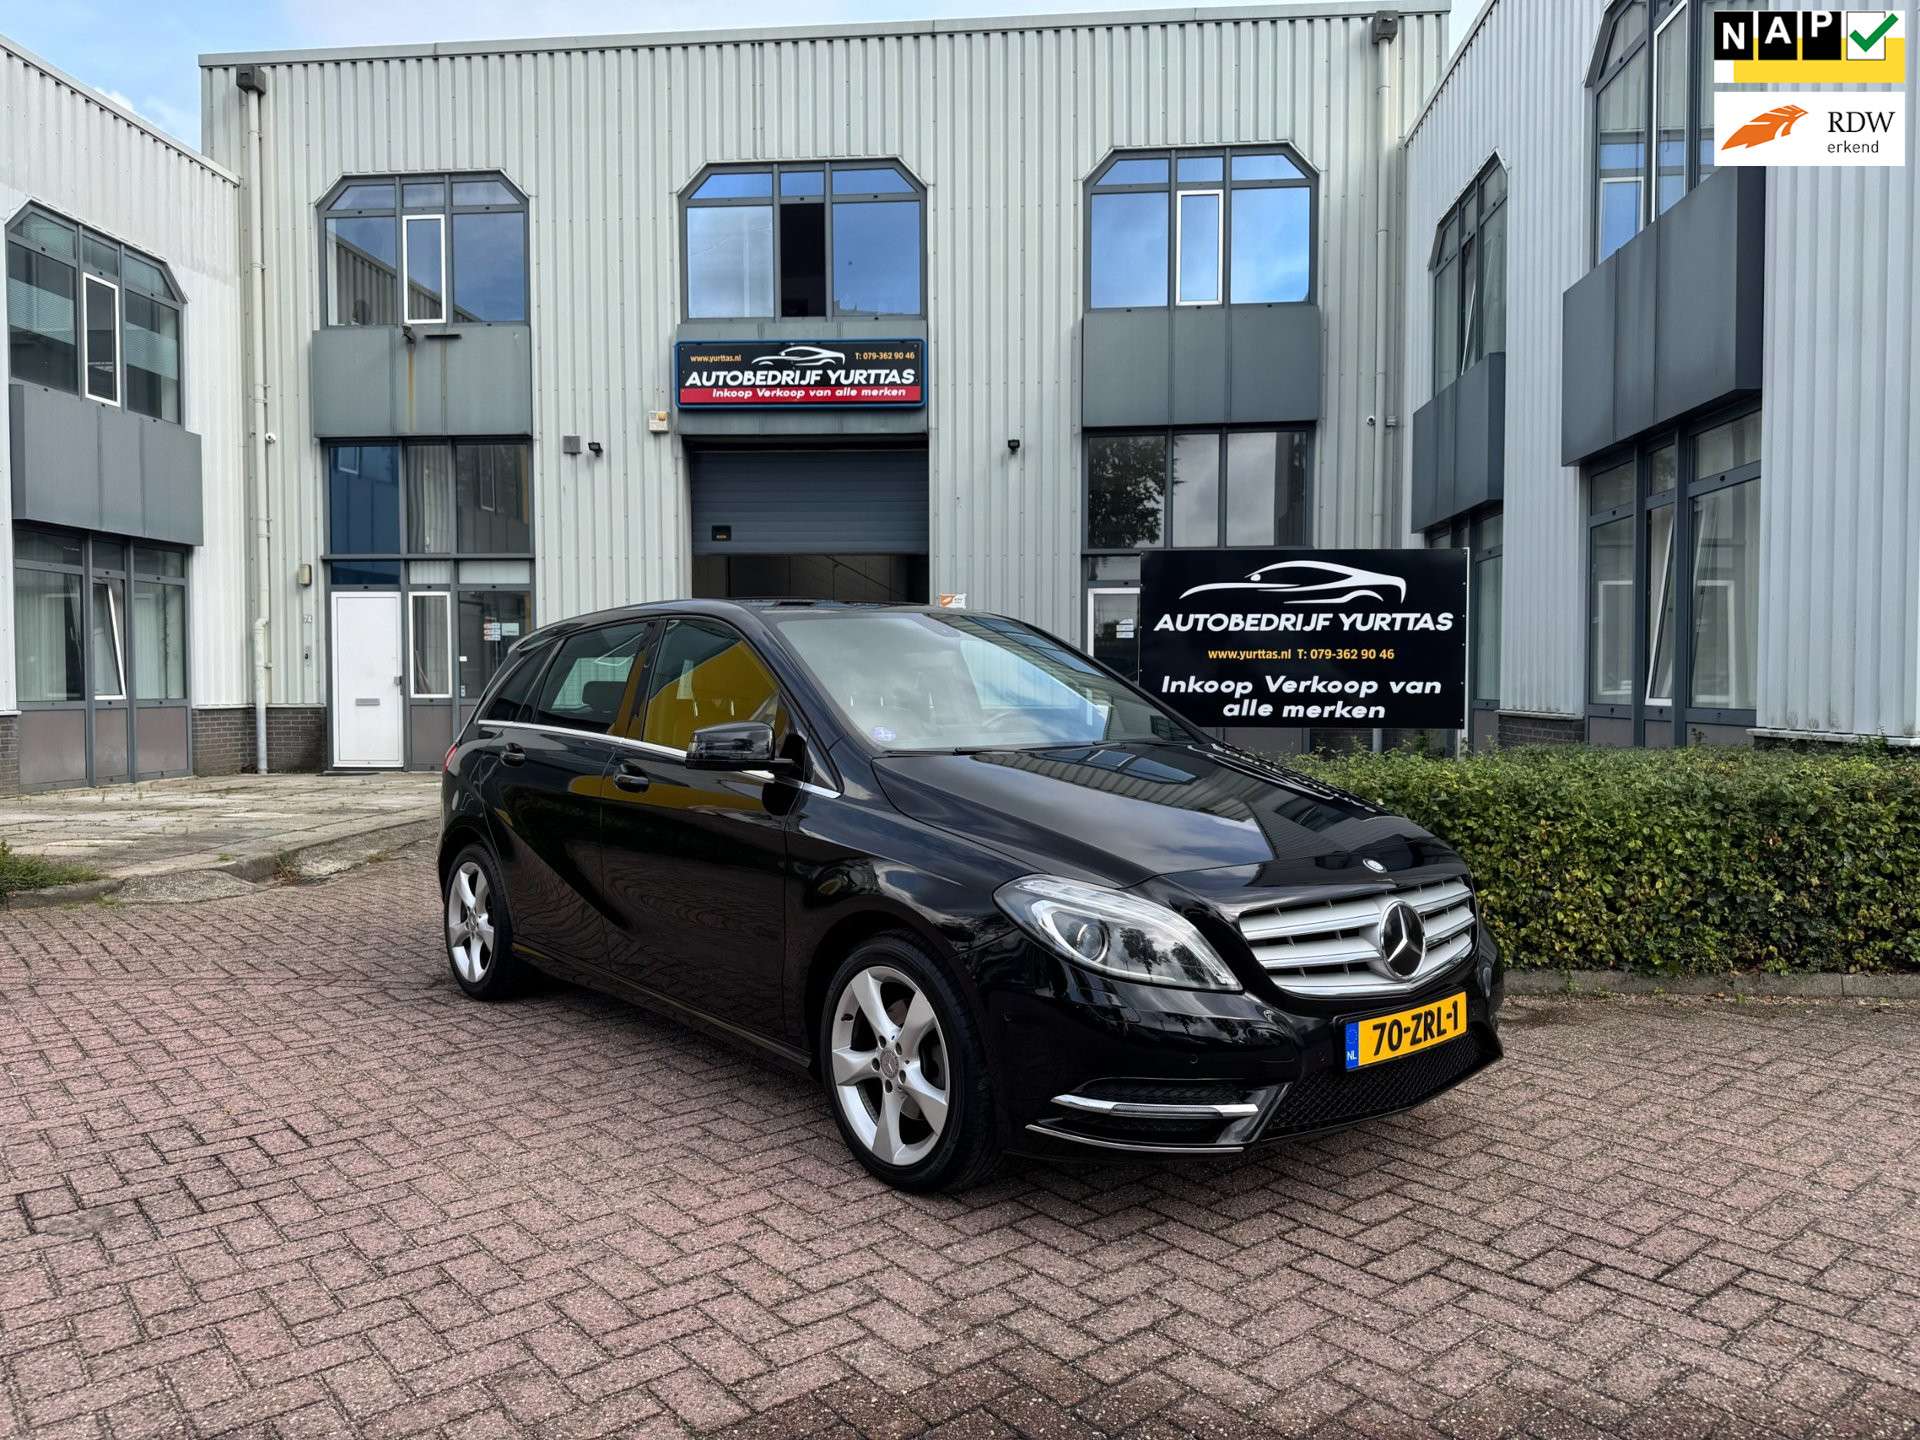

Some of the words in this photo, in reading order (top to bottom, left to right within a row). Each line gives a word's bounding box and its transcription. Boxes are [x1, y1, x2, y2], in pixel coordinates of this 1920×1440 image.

[690, 354, 742, 362] www.yurttas.nl
[855, 352, 862, 360] T:
[863, 351, 893, 360] 079-362
[894, 351, 904, 360] 90
[905, 351, 915, 360] 46
[685, 369, 822, 386] AUTOBEDRIJF
[827, 369, 915, 385] YURTTAS
[712, 388, 752, 399] Inkoop
[757, 388, 805, 399] Verkoop
[809, 389, 831, 397] van
[835, 388, 857, 397] alle
[861, 388, 906, 397] merken
[1153, 613, 1333, 632] AUTOBEDRIJF
[1338, 613, 1454, 631] YURTTAS
[1208, 649, 1291, 661] www.yurttas.nl
[1297, 650, 1308, 659] T:
[1310, 649, 1358, 659] 079-362
[1361, 649, 1377, 659] 90
[1379, 649, 1395, 659] 46
[1161, 675, 1253, 698] Inkoop
[1265, 675, 1379, 698] Verkoop
[1389, 680, 1442, 694] van
[1222, 699, 1273, 717] alle
[1282, 700, 1386, 718] merken
[1372, 1000, 1458, 1056] 70-ZRL-1
[1346, 1050, 1357, 1060] NL
